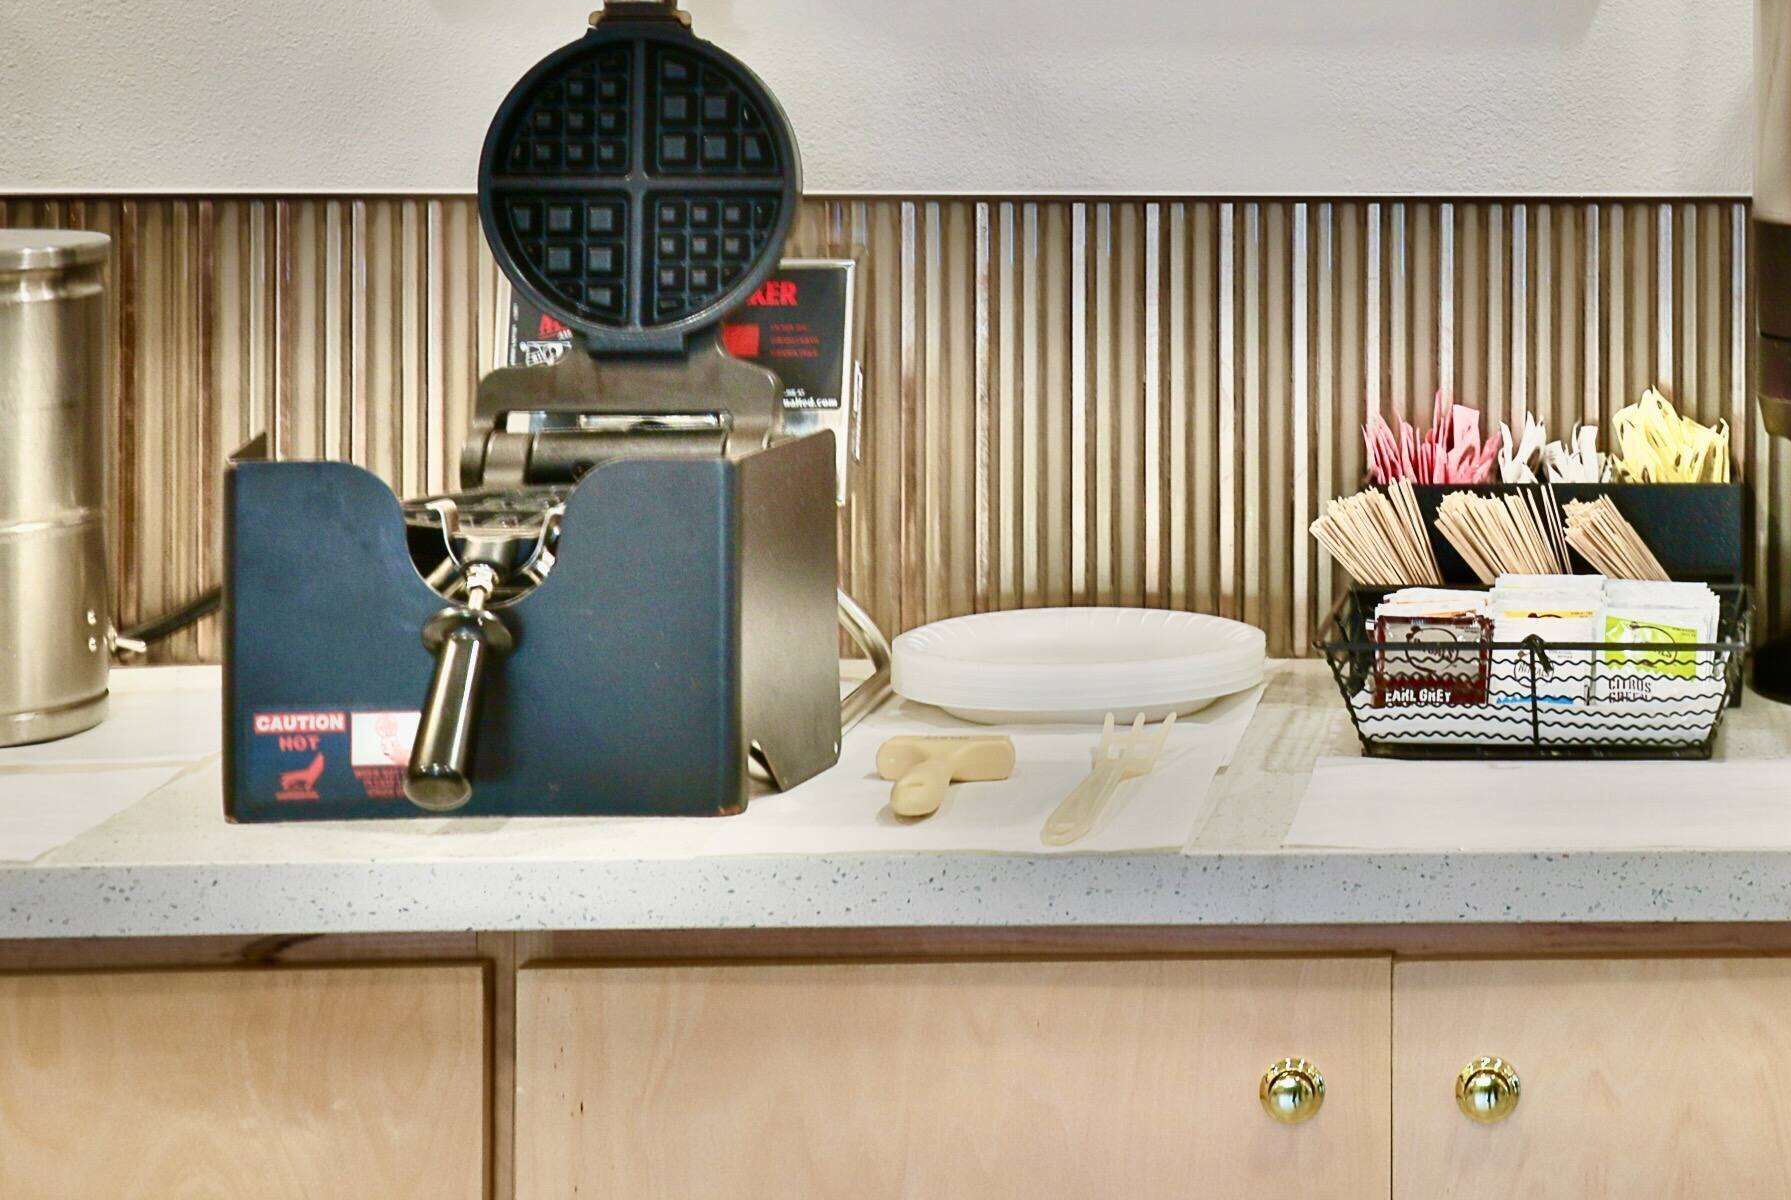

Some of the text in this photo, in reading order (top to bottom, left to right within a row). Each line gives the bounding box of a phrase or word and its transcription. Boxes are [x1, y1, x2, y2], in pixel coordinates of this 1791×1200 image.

[1385, 687, 1451, 703] EARL GREY
[255, 714, 344, 732] CAUTION
[279, 736, 320, 751] HOT
